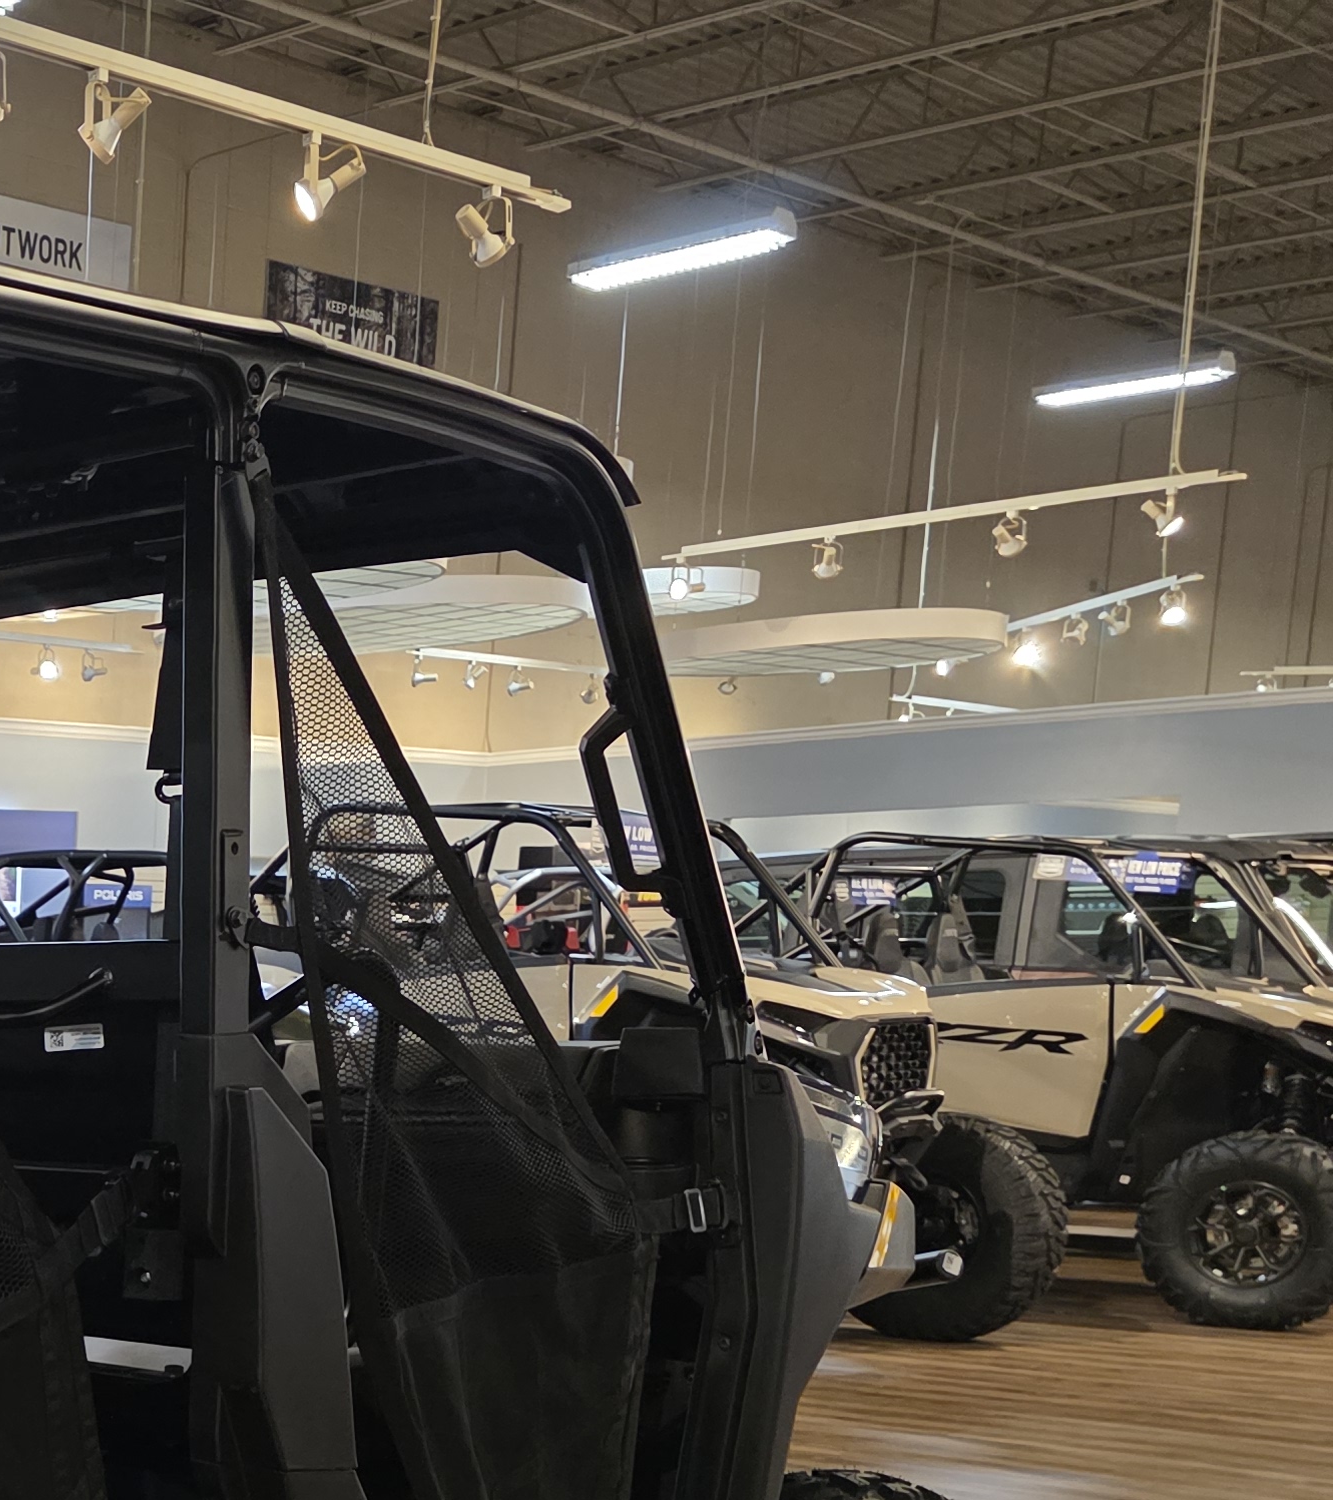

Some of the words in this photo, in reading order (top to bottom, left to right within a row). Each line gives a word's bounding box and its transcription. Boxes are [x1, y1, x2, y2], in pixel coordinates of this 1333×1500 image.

[325, 298, 348, 315] KEEP
[348, 304, 385, 324] CHASING
[309, 317, 347, 341] THE
[350, 325, 397, 358] WILD
